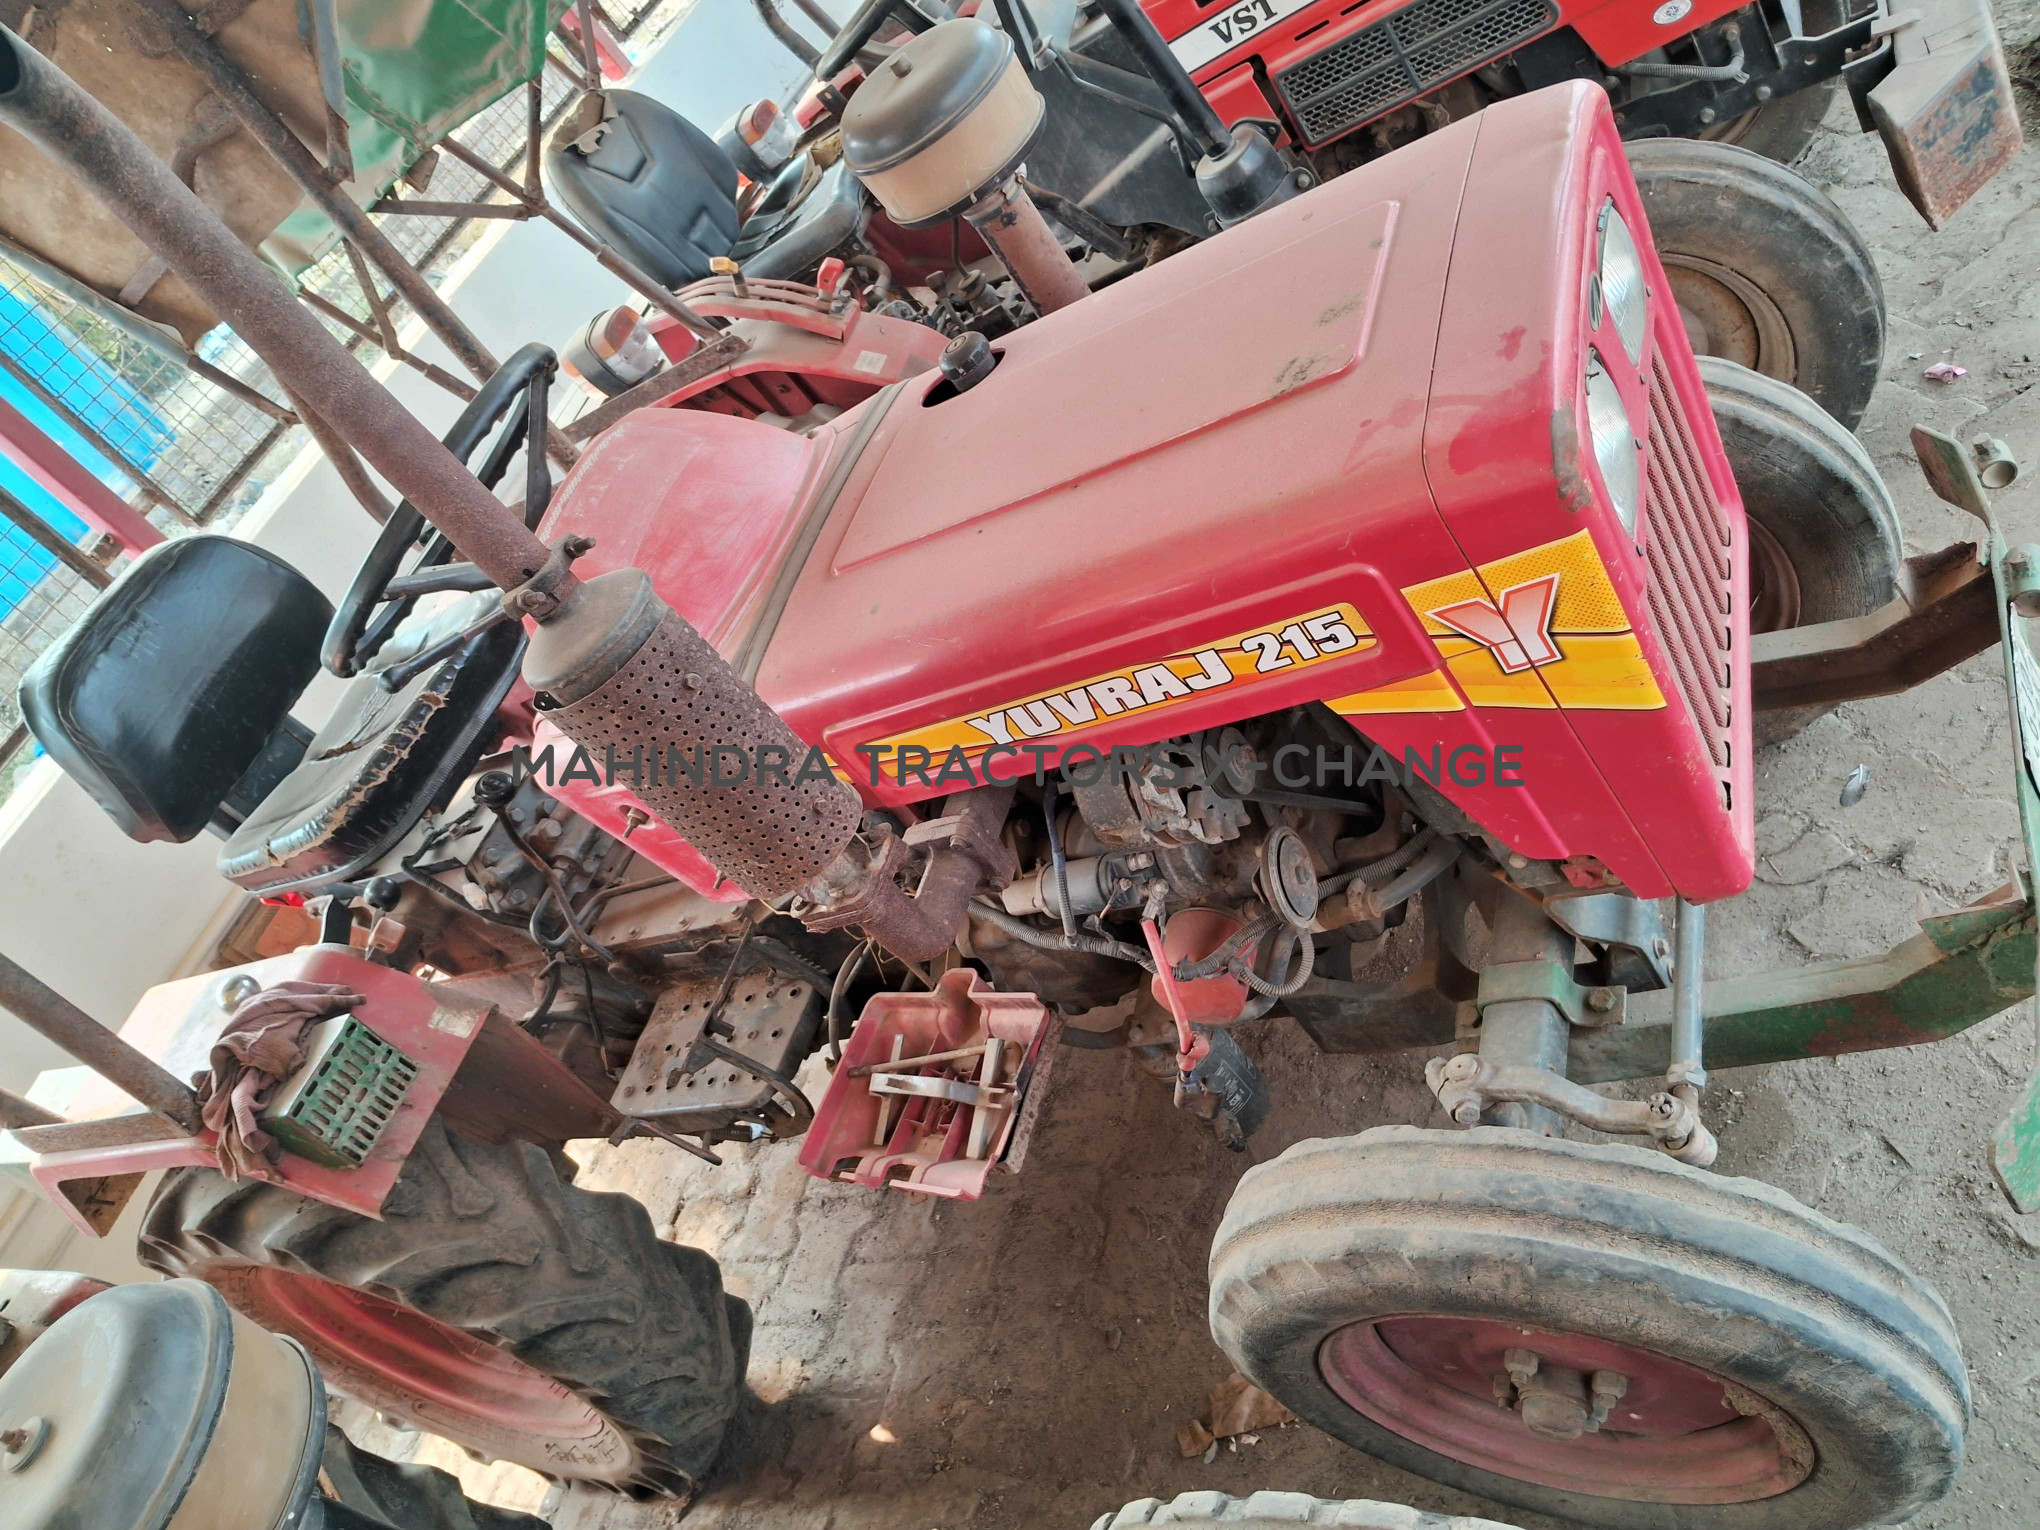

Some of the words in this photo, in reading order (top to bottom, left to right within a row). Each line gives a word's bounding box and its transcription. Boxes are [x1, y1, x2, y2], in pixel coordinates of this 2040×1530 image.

[1208, 0, 1278, 44] VST
[965, 648, 1234, 744] YUVRAJ
[1240, 611, 1358, 673] 215
